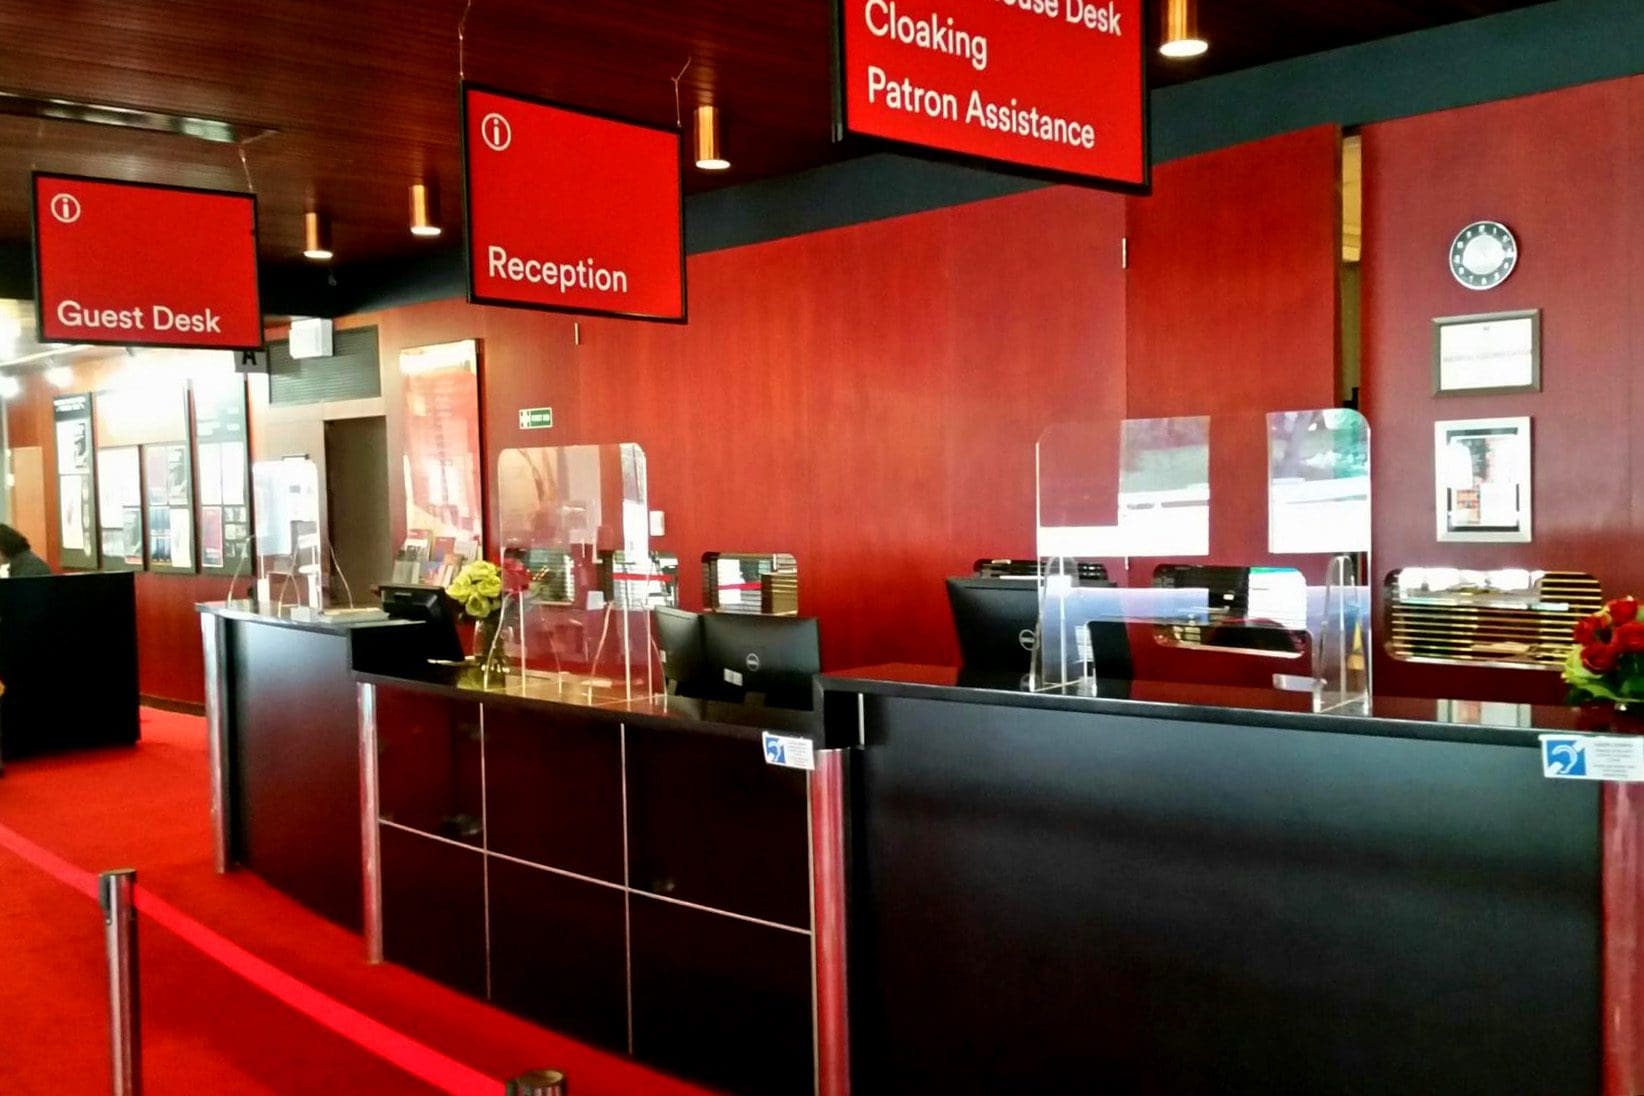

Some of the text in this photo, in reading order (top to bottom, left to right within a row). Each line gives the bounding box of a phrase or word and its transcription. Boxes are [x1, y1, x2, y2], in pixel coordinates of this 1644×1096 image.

[864, 0, 988, 71] Cloaking
[1066, 0, 1122, 36] Desk
[867, 65, 1096, 149] Patron Assistance
[488, 244, 628, 294] Reception
[57, 299, 222, 334] Guest Desk
